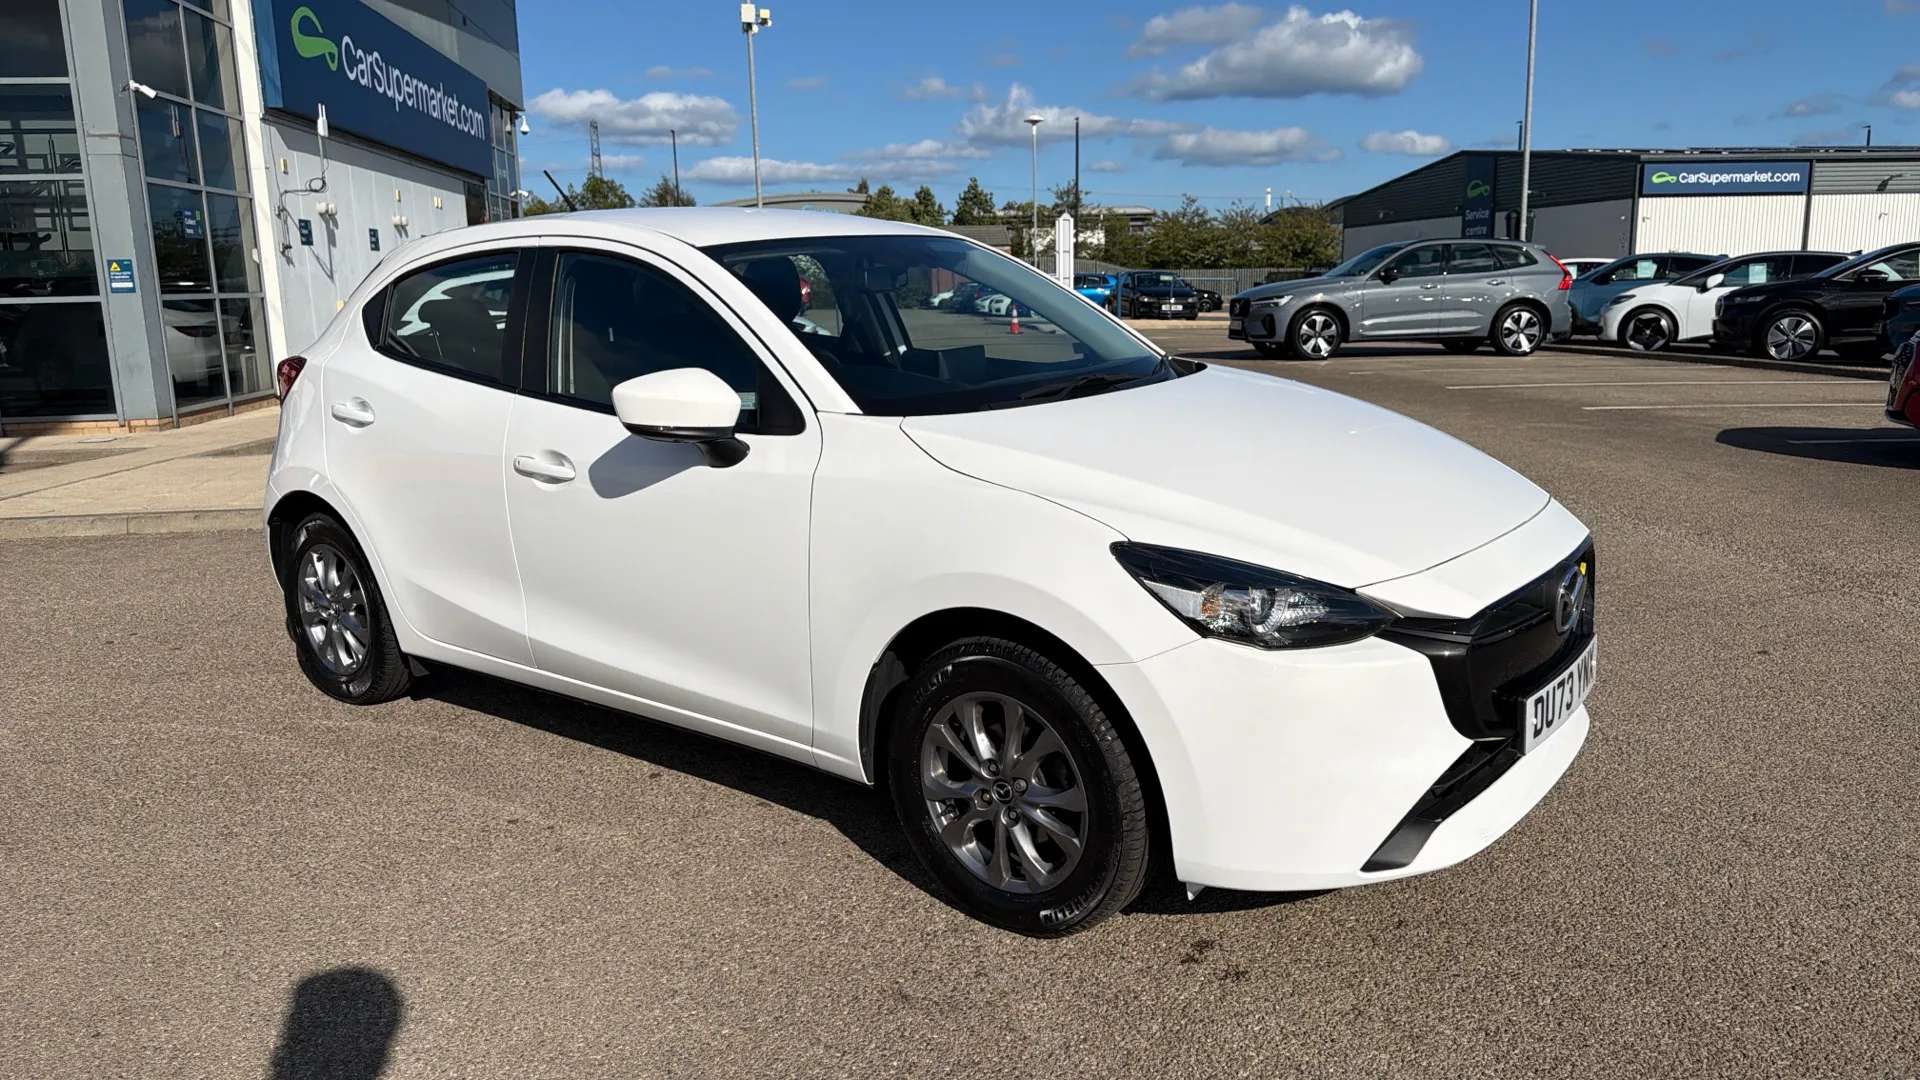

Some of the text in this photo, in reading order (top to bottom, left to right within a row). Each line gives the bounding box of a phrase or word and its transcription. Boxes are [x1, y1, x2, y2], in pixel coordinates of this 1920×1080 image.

[341, 35, 486, 141] CarSupermarket.com
[1678, 170, 1801, 186] CarSupermarket.com
[1464, 208, 1490, 221] Service
[1533, 671, 1574, 740] DU73
